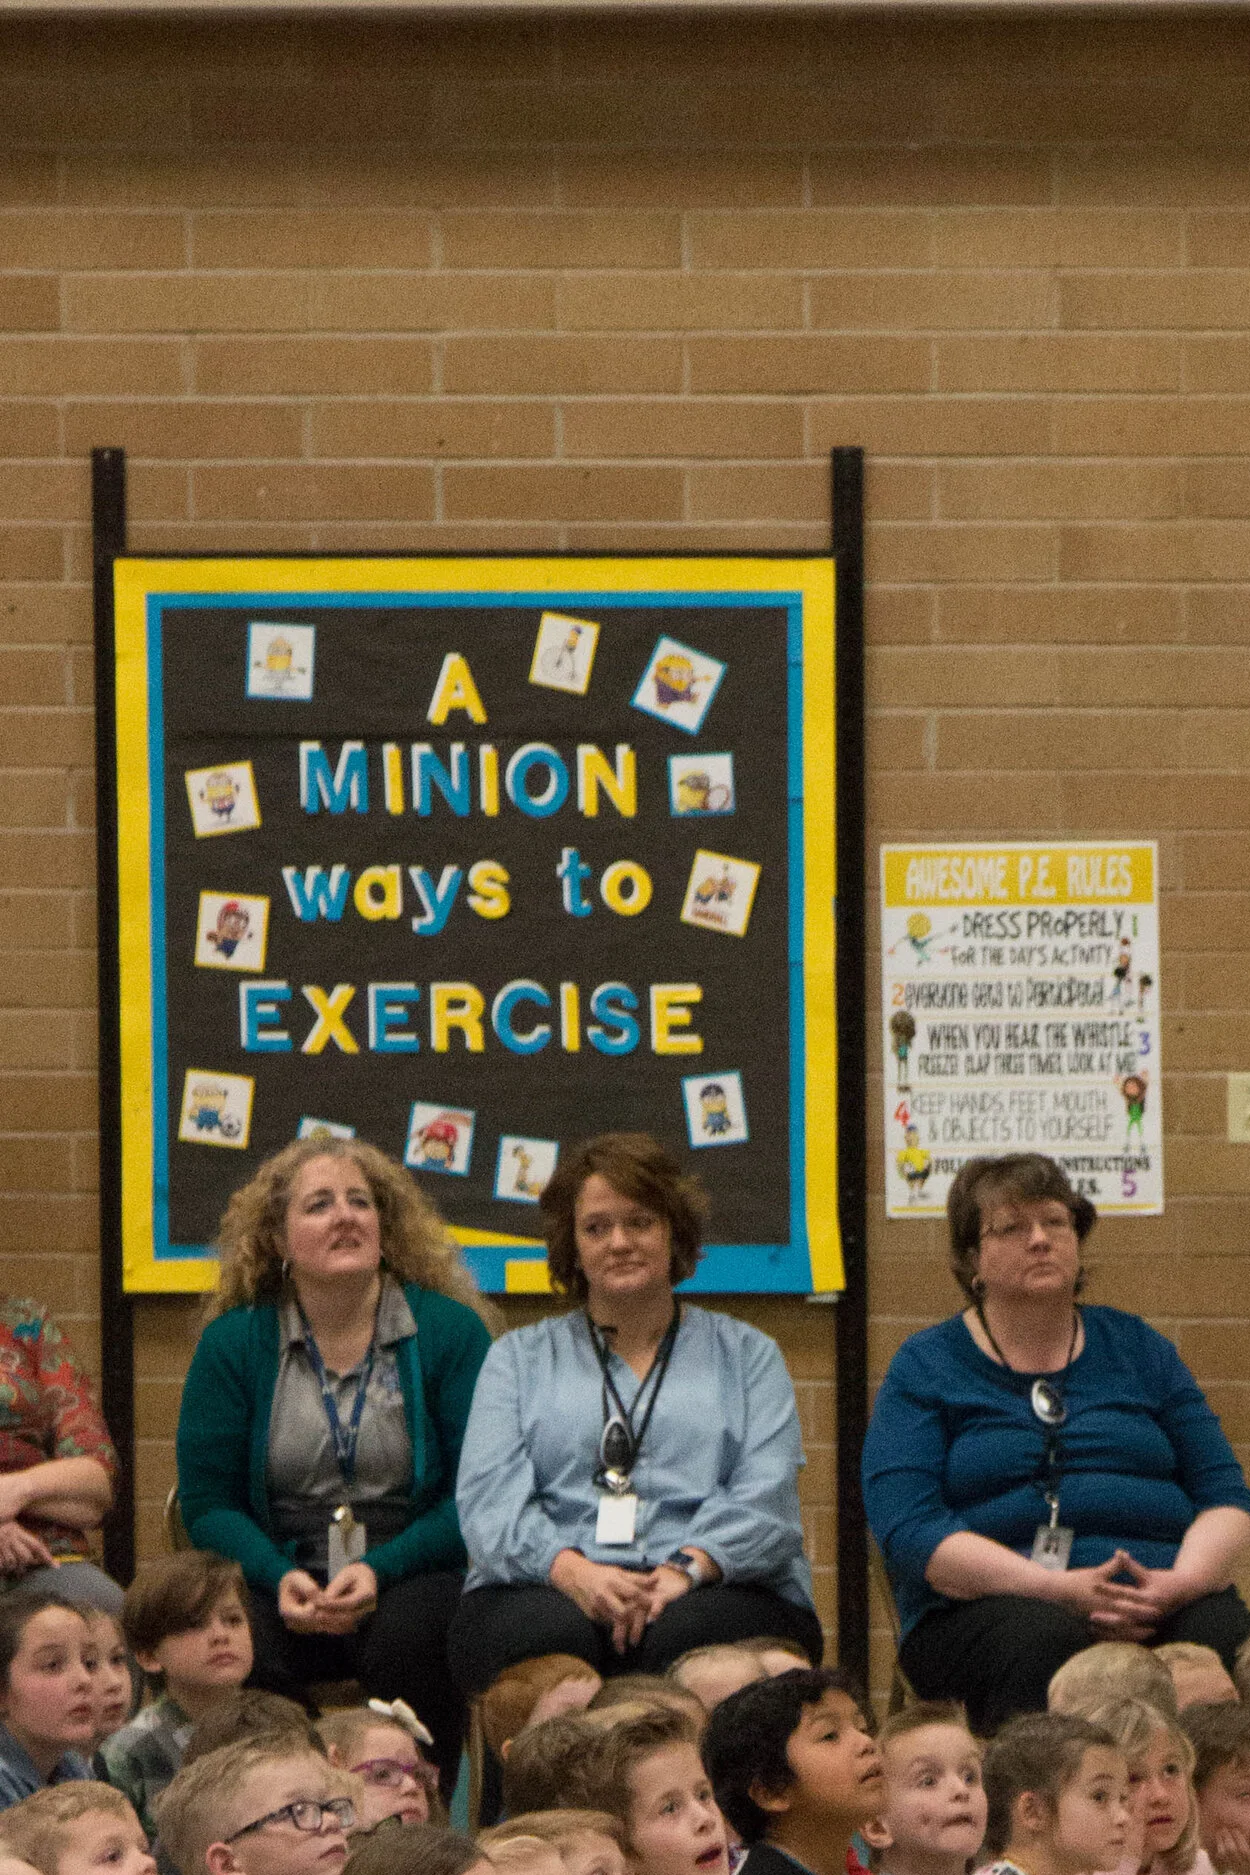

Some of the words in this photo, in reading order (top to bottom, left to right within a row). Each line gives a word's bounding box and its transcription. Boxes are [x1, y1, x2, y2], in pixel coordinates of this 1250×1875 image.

[427, 652, 488, 725] A
[300, 740, 636, 818] MINION
[905, 856, 1008, 899] AWESOME
[1067, 854, 1132, 896] RULES
[282, 860, 511, 936] ways
[557, 847, 653, 917] to
[963, 911, 1021, 938] DRESS
[982, 945, 1004, 966] THE
[892, 983, 905, 1006] 2
[239, 978, 704, 1056] EXERCISE
[927, 1023, 969, 1050] WHEN
[973, 1023, 999, 1049] YOU
[1005, 1022, 1039, 1049] HEAR
[1045, 1022, 1067, 1048] THE
[1138, 1031, 1150, 1055] 3
[894, 1100, 910, 1126] 4
[911, 1090, 946, 1114] KEEP
[943, 1116, 1011, 1142] OBJECTS
[1016, 1115, 1034, 1141] TO
[1041, 1114, 1113, 1142] YOURSELF
[1121, 1168, 1138, 1197] 5
